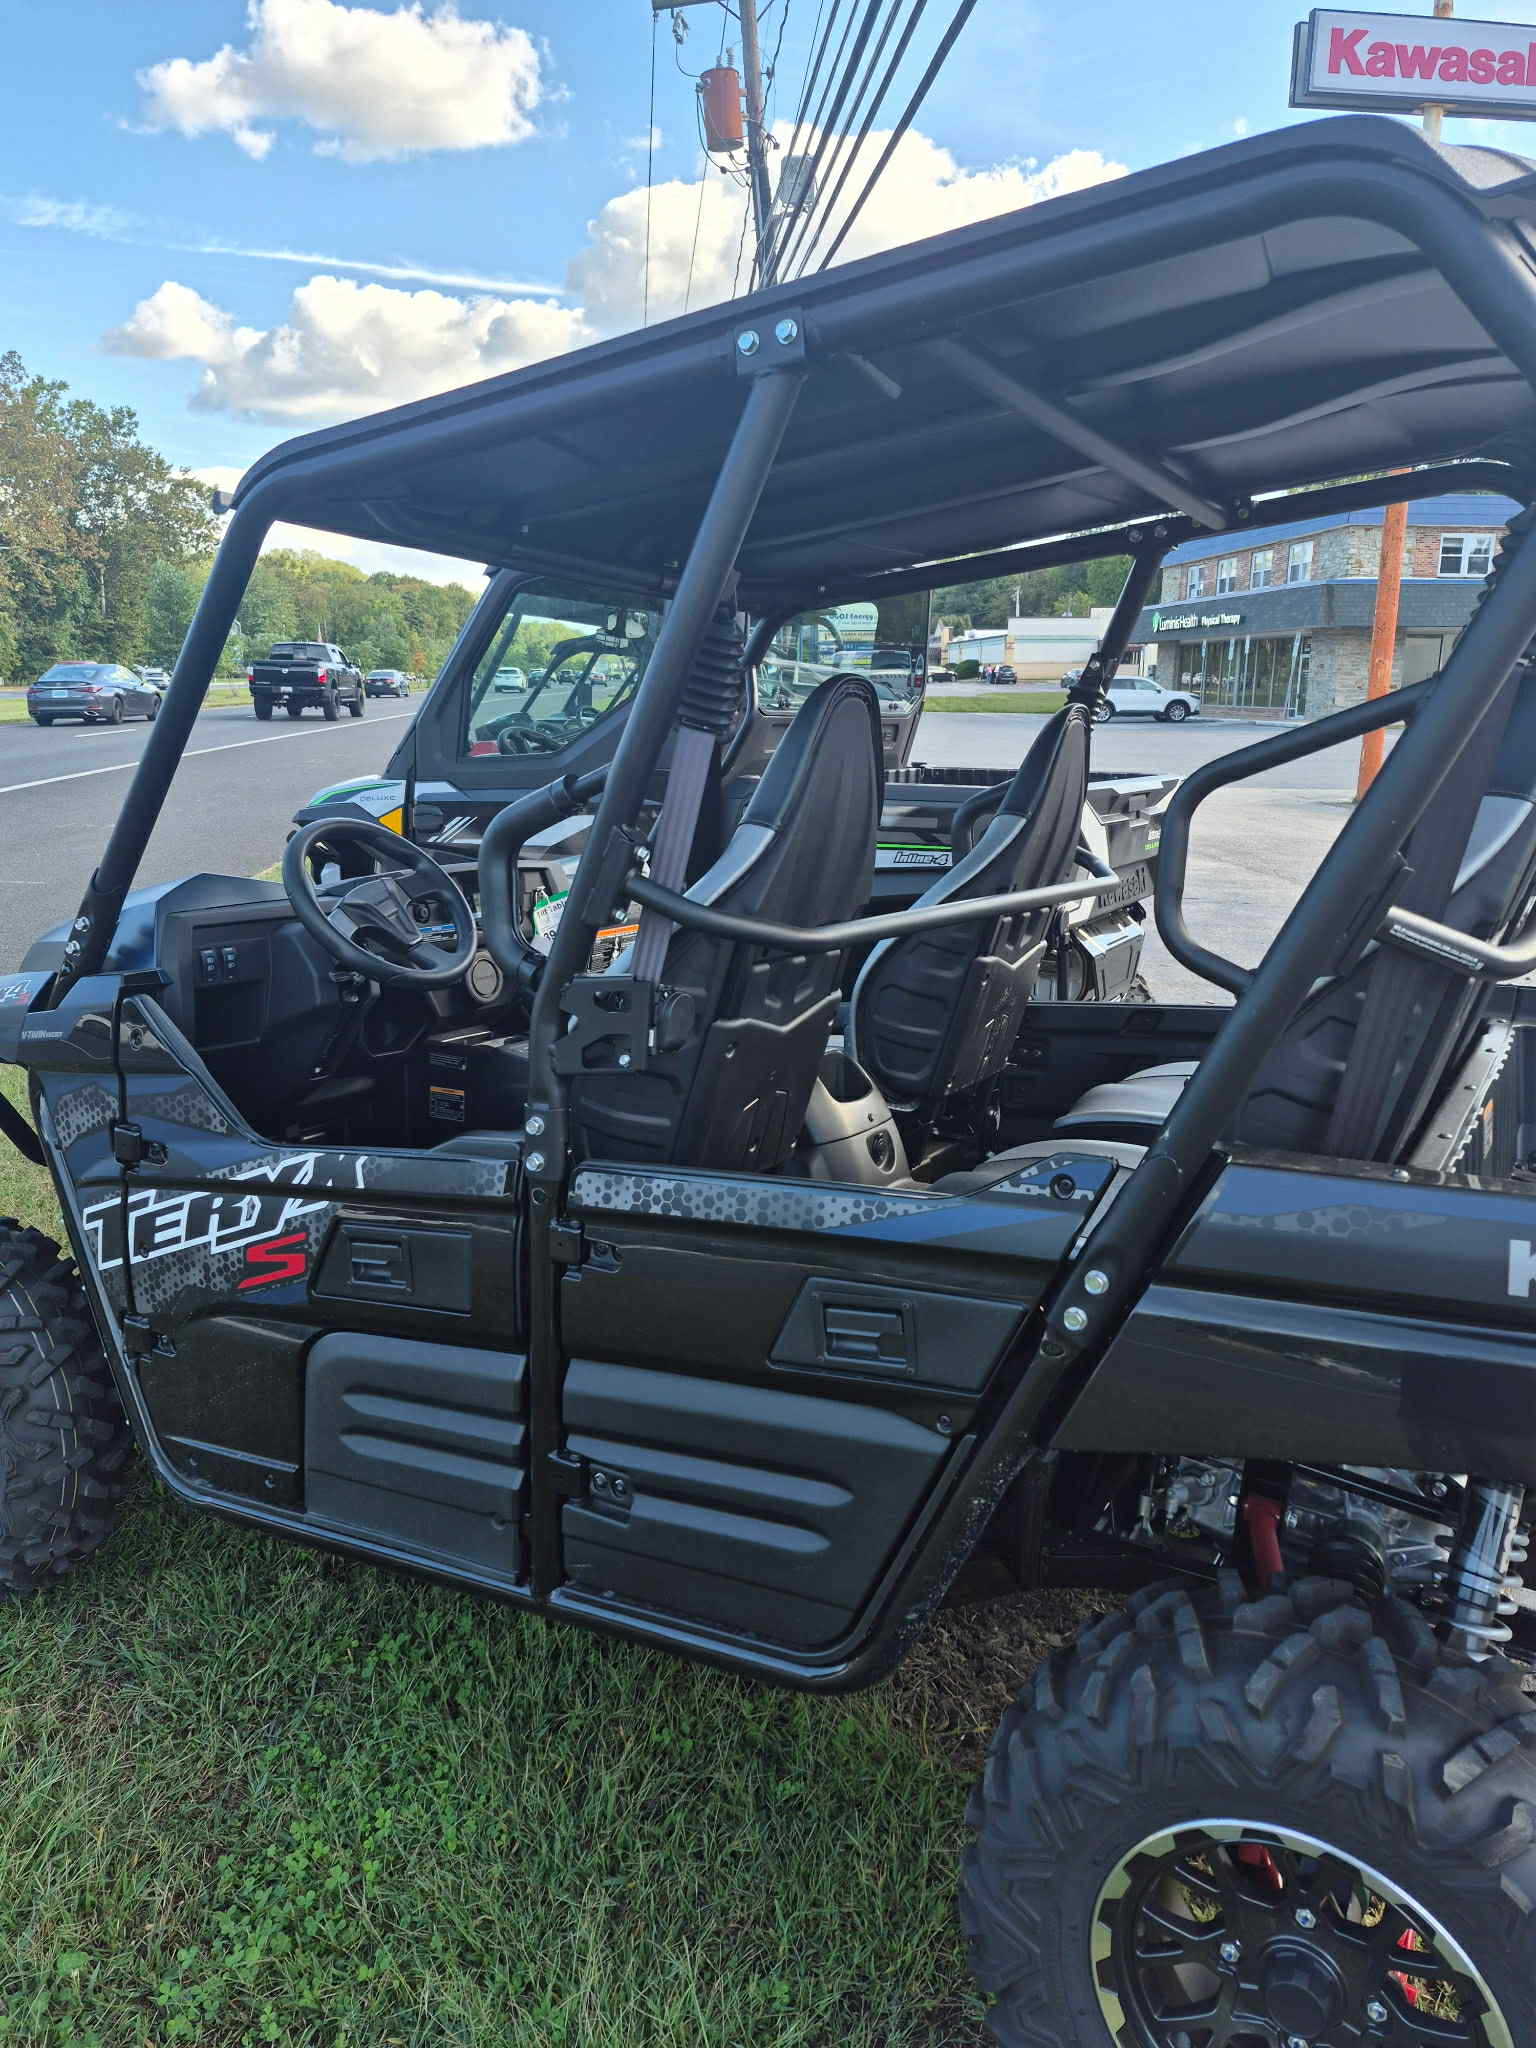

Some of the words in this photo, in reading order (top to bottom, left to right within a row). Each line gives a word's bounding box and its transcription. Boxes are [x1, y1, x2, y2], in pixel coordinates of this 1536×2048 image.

[1327, 27, 1536, 87] Kawasa
[1220, 612, 1241, 625] Therapy
[893, 851, 950, 866] Inline-4
